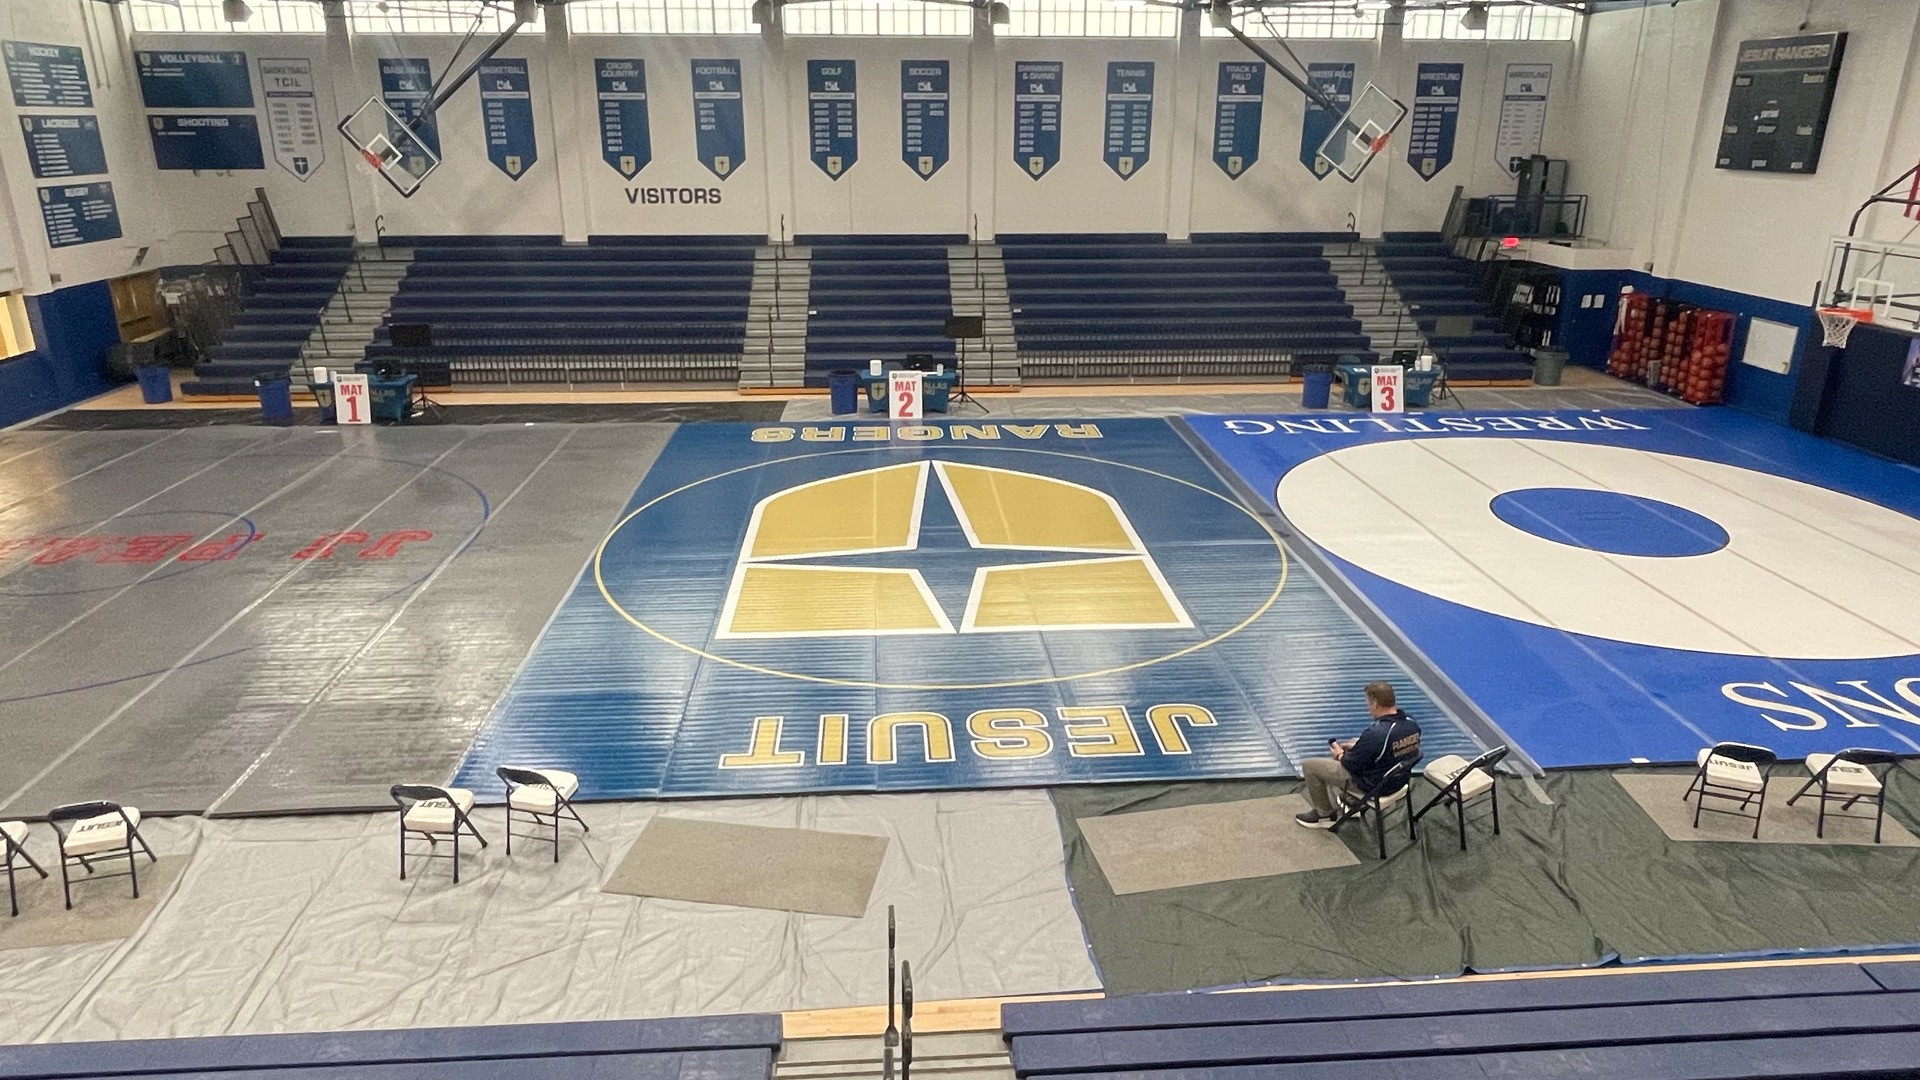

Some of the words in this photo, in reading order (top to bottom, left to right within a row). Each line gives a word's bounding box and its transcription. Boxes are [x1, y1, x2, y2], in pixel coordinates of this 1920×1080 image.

[1776, 44, 1830, 60] RANGERS
[159, 54, 223, 63] VOLLEYBALL
[480, 66, 526, 74] BASKETBALL
[606, 62, 633, 70] CROSS
[695, 67, 737, 75] FOOTBALL
[821, 67, 842, 75] GOLF
[1116, 69, 1146, 77] TENNIS
[1509, 71, 1549, 79] WRESTLING
[177, 118, 229, 127] SHOOTING
[625, 187, 722, 204] VISITORS
[1377, 375, 1397, 386] MAT
[340, 384, 362, 395] MAT
[895, 381, 916, 392] MAT
[899, 392, 913, 417] 2
[1380, 387, 1395, 411] 3
[346, 396, 361, 422] 1
[1224, 416, 1652, 435] WRESTLING
[750, 425, 1104, 443] RANGERS
[1721, 677, 1920, 731] NS
[718, 703, 1218, 769] JESUIT
